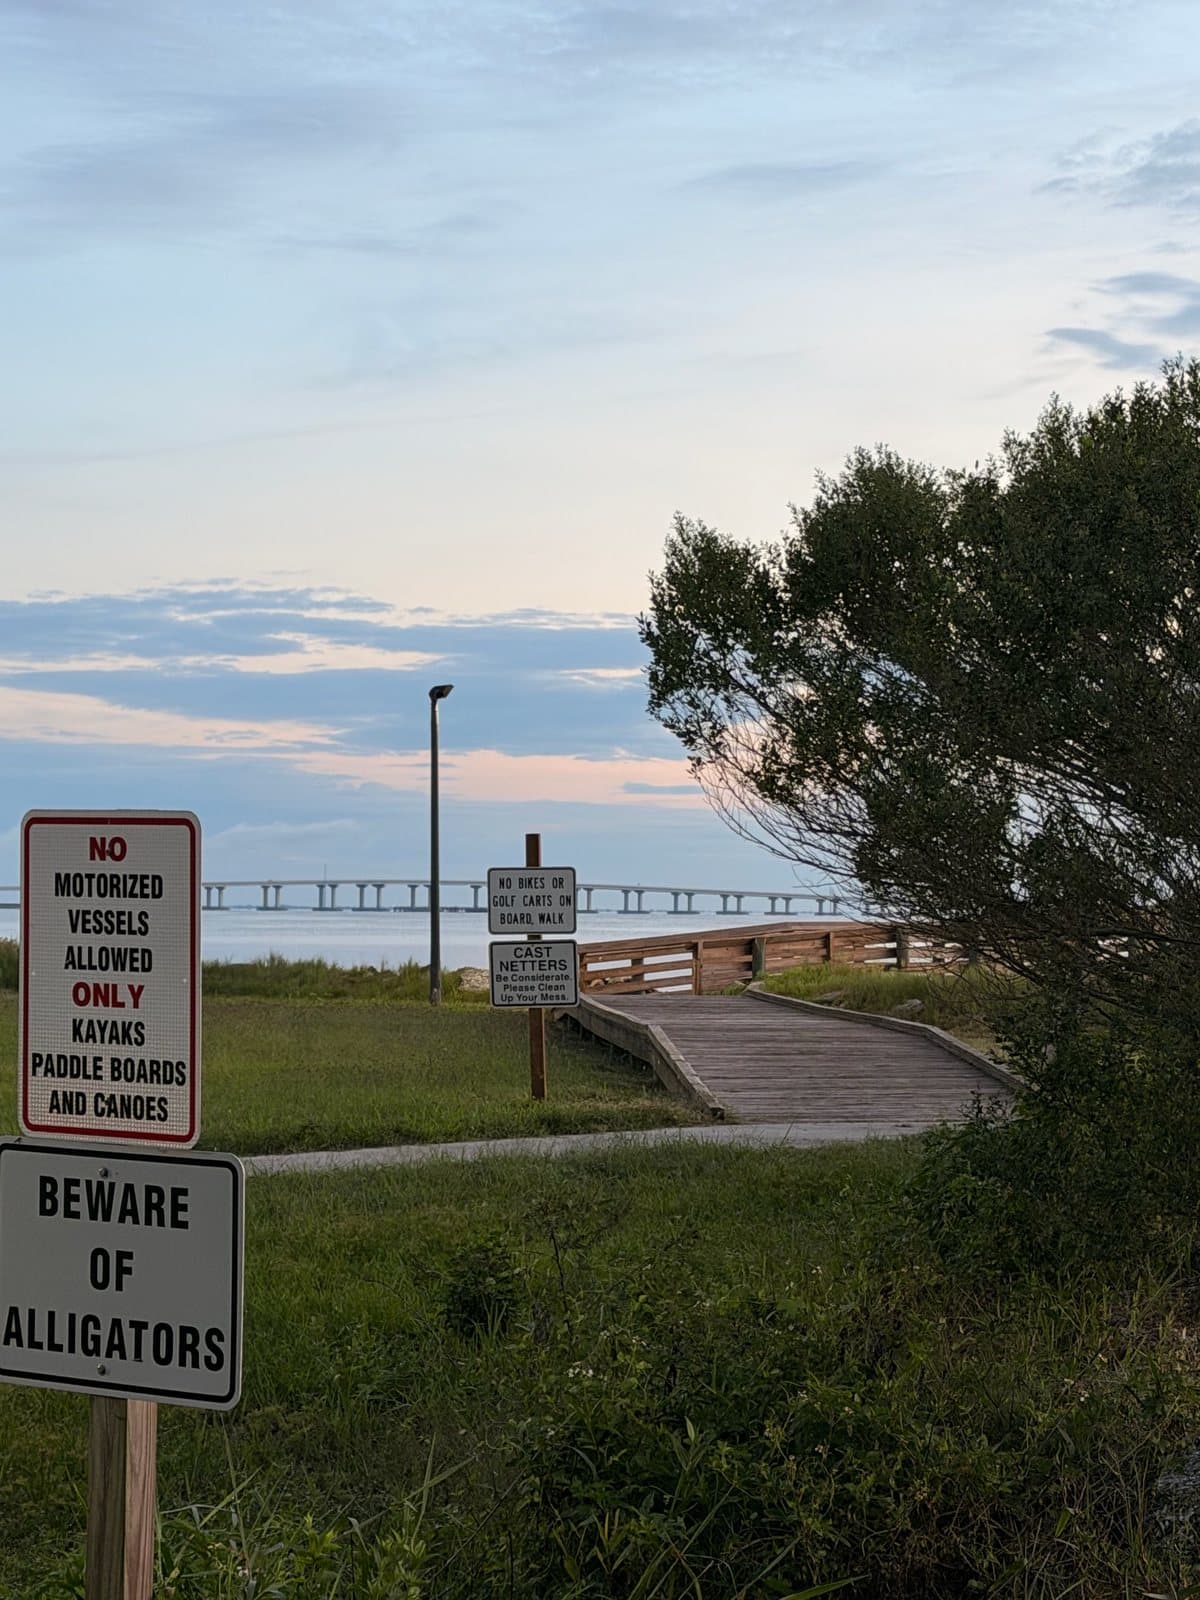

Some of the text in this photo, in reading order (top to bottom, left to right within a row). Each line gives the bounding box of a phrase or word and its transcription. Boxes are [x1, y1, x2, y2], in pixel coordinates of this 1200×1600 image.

[89, 837, 127, 861] NO
[55, 872, 163, 899] MOTORIZED
[499, 877, 564, 889] NO BIKES OR
[493, 895, 571, 907] GOLF CARTS ON
[68, 909, 149, 936] VESSELS
[538, 913, 564, 924] WALK
[64, 945, 153, 973] ALLOWED
[499, 960, 567, 972] NETTERS
[514, 947, 552, 958] CAST
[496, 973, 572, 982] Be Considerate.
[504, 983, 565, 992] Please Clean
[72, 982, 145, 1009] ONLY
[501, 993, 568, 1002] Up Your Mess.
[72, 1018, 145, 1046] KAYAKS
[31, 1053, 186, 1086] PADDLE BOARDS
[49, 1090, 168, 1121] AND CANOES
[39, 1175, 189, 1230] BEWARE
[89, 1247, 134, 1292] OF
[2, 1306, 225, 1372] ALLIGATORS
